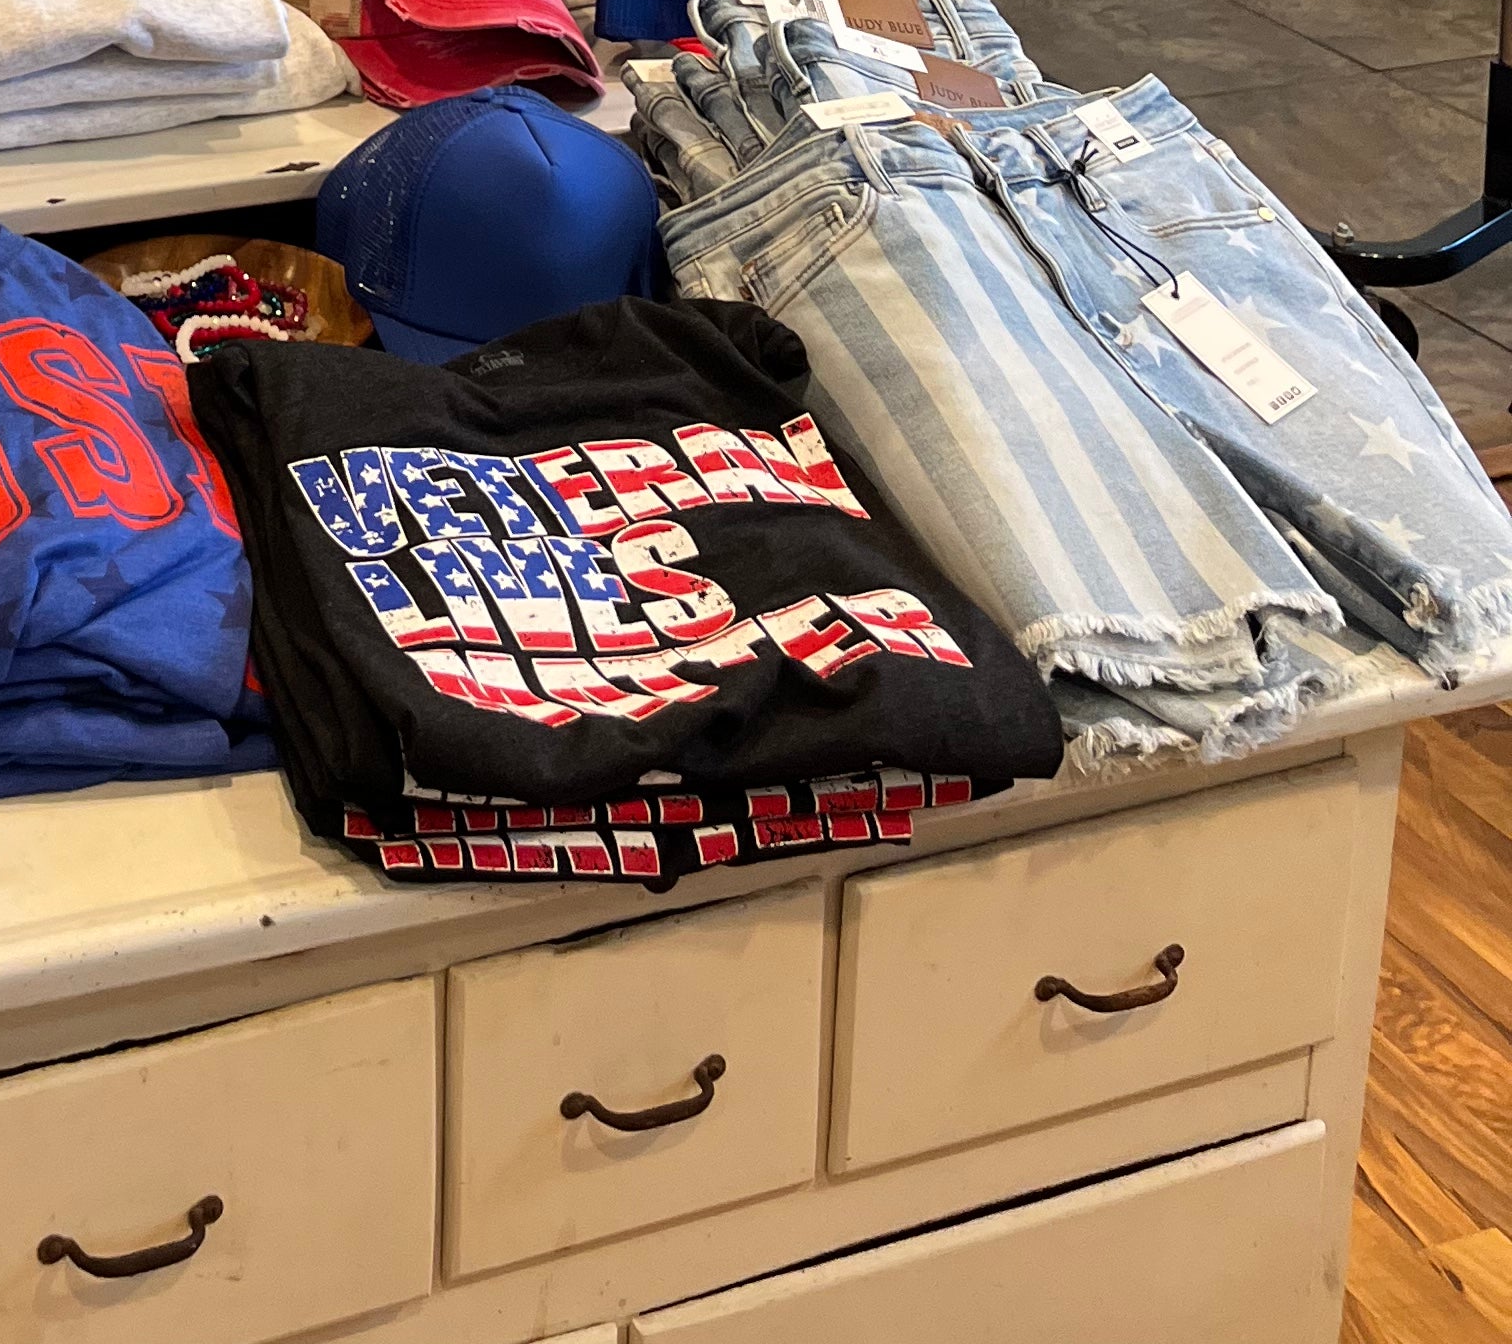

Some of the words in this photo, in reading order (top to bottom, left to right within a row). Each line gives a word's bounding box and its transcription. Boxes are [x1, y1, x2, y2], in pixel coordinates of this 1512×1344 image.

[887, 20, 925, 37] BLUE
[288, 412, 871, 558] VETERAN
[345, 518, 736, 652] LIVES
